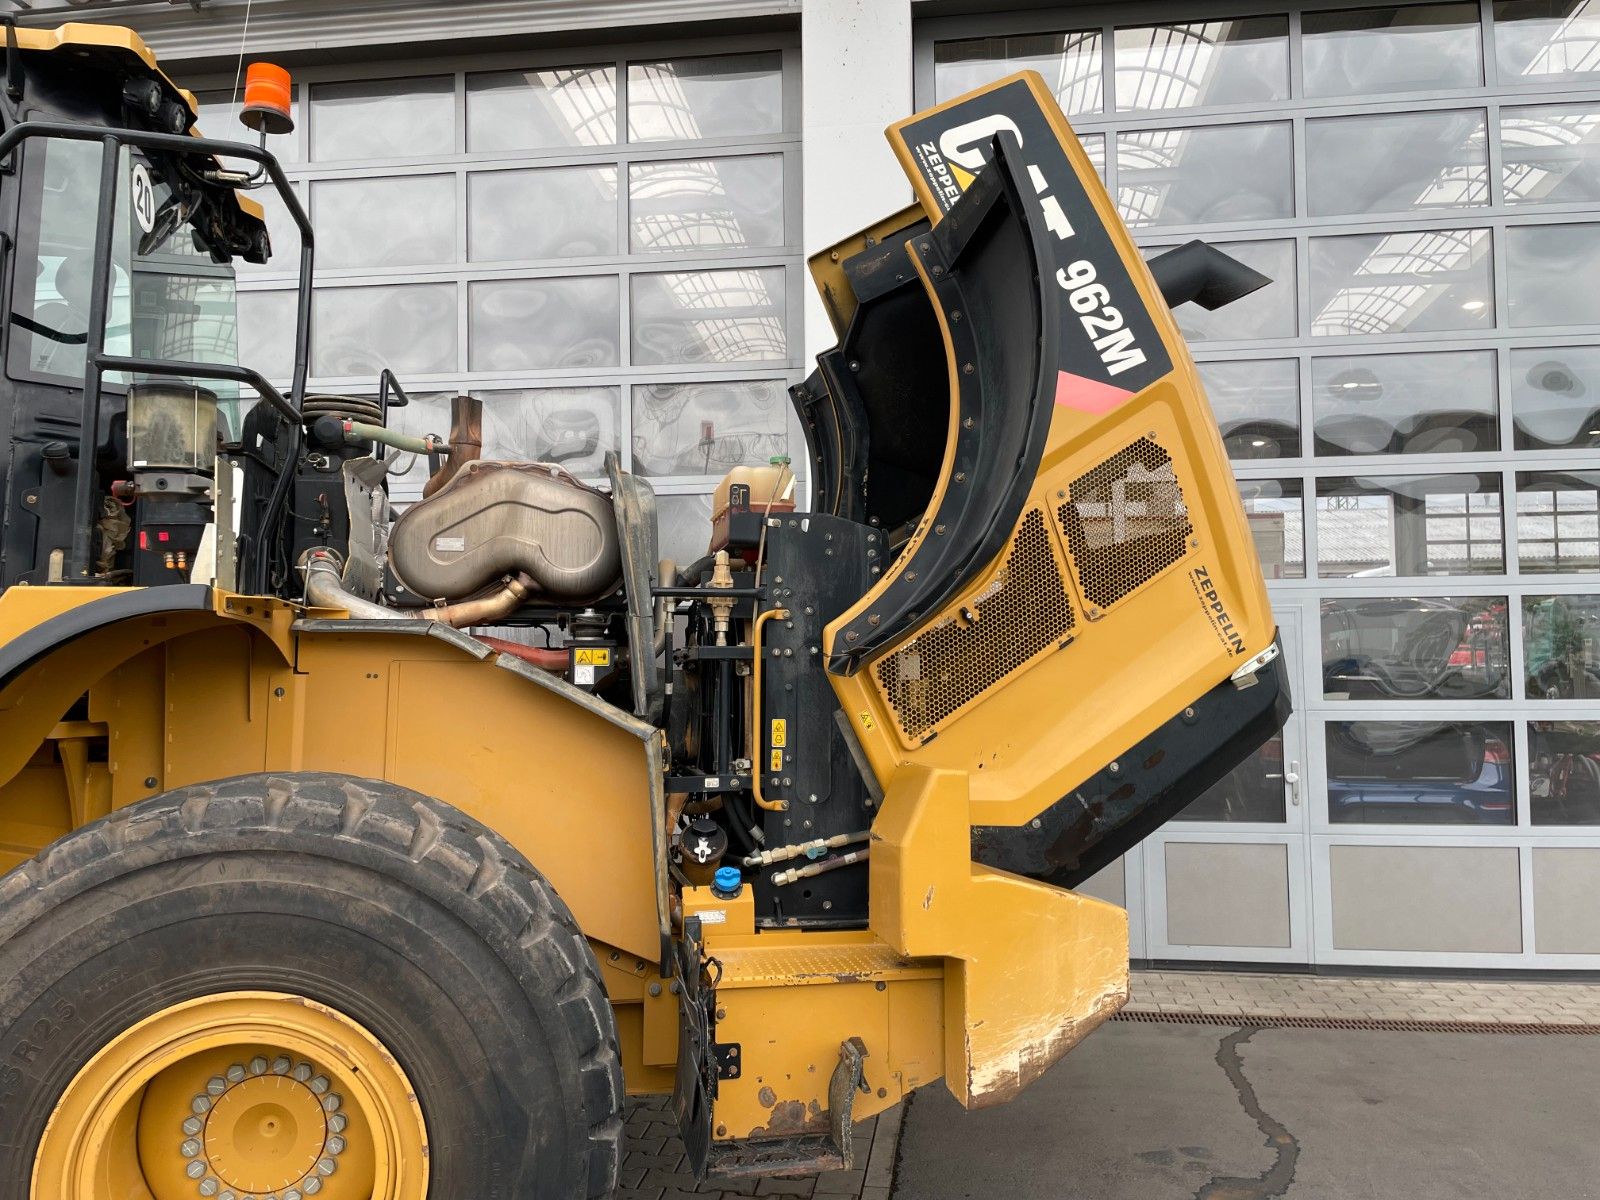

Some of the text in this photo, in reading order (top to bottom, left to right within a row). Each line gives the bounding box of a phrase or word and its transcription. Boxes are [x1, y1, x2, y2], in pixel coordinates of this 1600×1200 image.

[136, 174, 151, 225] 20
[1056, 260, 1147, 377] 962M
[1188, 571, 1233, 658] www.zeppelin-cat.de
[1193, 565, 1246, 655] ZEPPELIN
